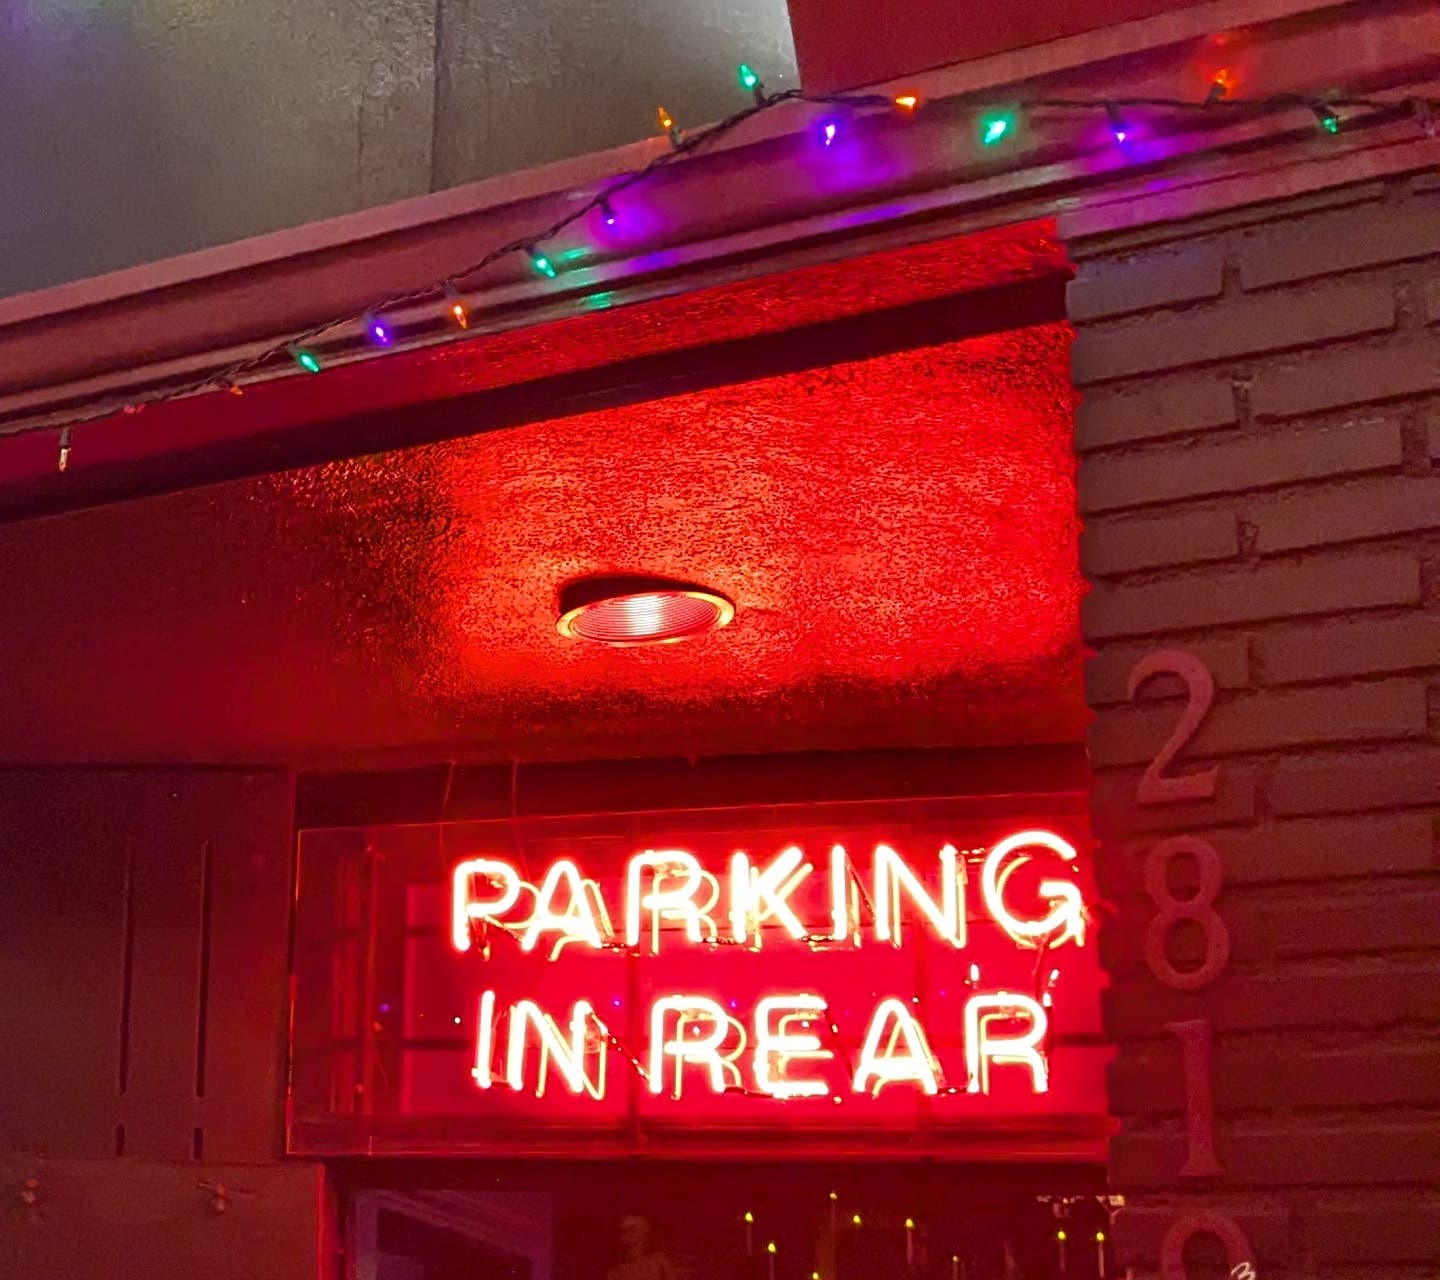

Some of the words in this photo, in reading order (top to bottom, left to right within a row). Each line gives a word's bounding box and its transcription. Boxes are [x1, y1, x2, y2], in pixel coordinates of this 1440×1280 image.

[452, 830, 1086, 952] PARKING
[472, 989, 592, 1094] IN
[647, 992, 1049, 1096] REAR
